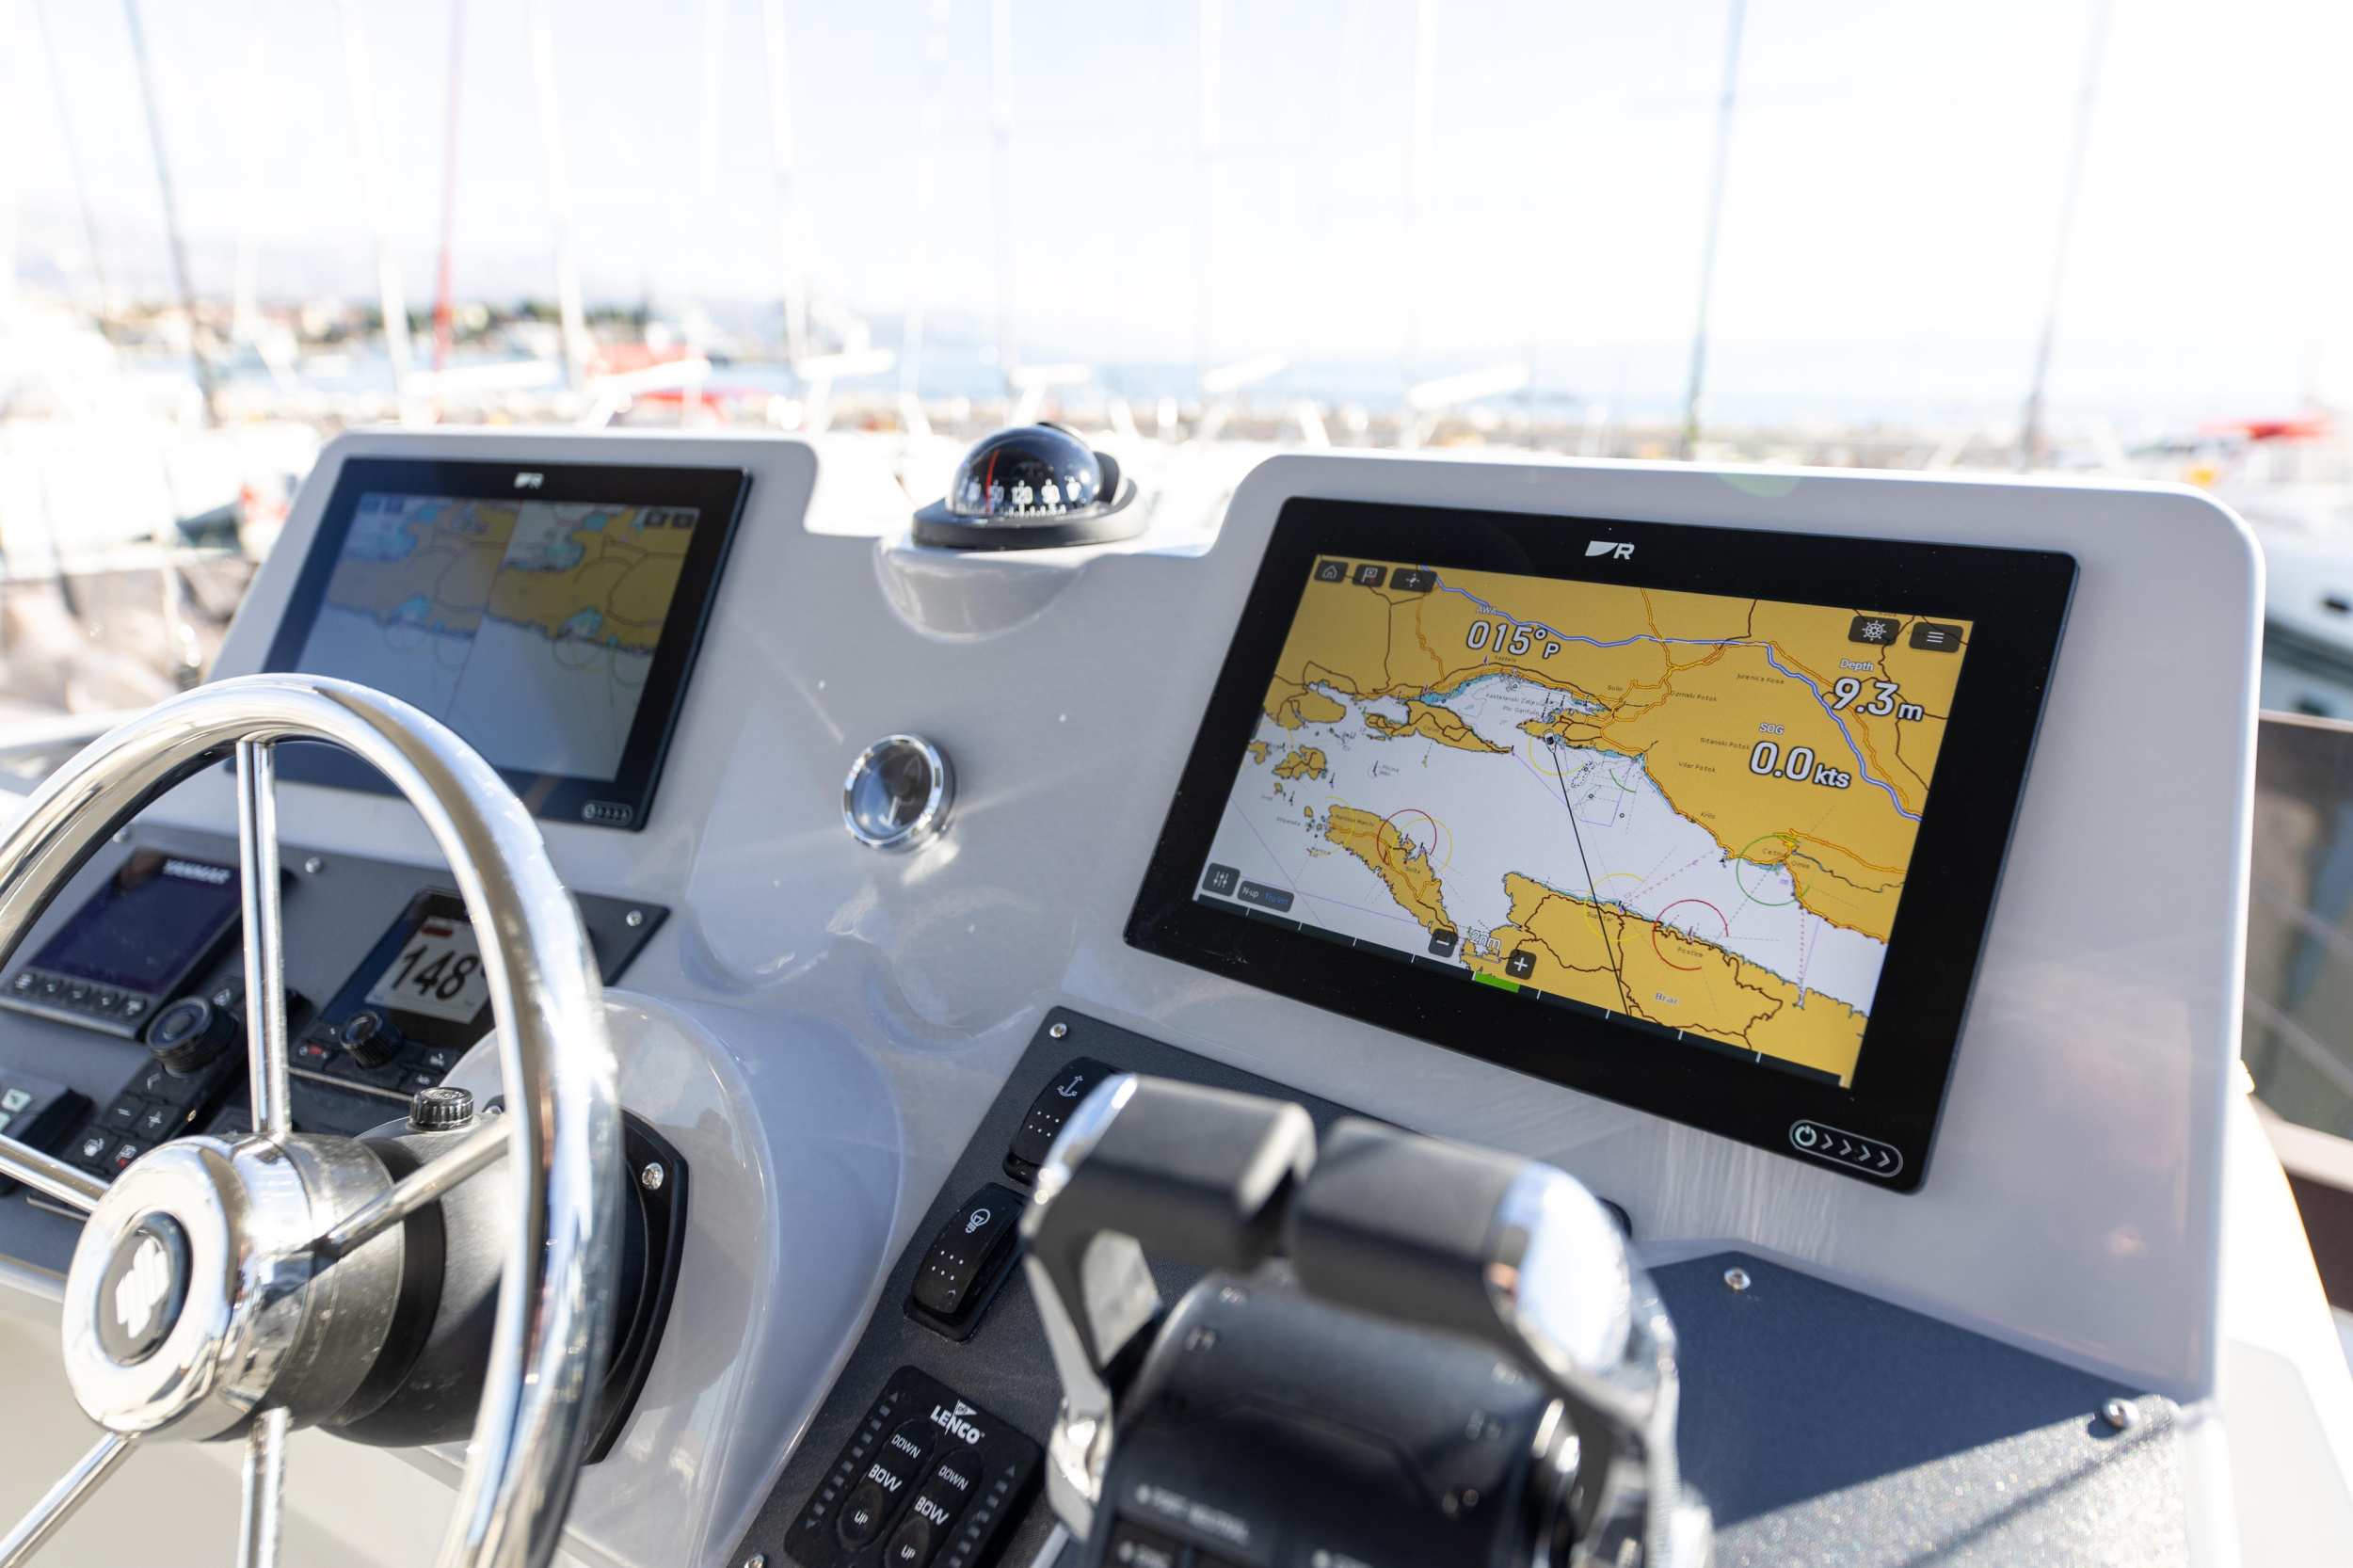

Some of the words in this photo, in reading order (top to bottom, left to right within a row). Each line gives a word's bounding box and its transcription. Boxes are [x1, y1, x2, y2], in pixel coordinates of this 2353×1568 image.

[1476, 605, 1497, 615] AWA
[1839, 659, 1874, 671] Depth
[1737, 673, 1765, 682] Jurenica
[1696, 694, 1718, 702] Potok
[1759, 722, 1785, 735] SOG
[1700, 737, 1728, 747] Sitanski
[1729, 741, 1751, 750] Potok
[1678, 760, 1694, 769] Vilar
[1695, 764, 1717, 773] Potok
[1700, 811, 1716, 820] Krilo
[1405, 866, 1421, 874] Solta
[1242, 887, 1259, 899] N-up
[1265, 892, 1276, 903] Tru
[1470, 931, 1501, 951] 2nm
[1677, 946, 1704, 958] Postire
[1655, 992, 1680, 1005] Brac
[930, 1404, 981, 1445] LENCO
[891, 1433, 921, 1459] DOWN
[868, 1464, 903, 1493] BOW
[938, 1465, 969, 1491] DOWN
[914, 1496, 950, 1526] BOW
[854, 1511, 869, 1525] UP
[901, 1544, 916, 1560] UP
